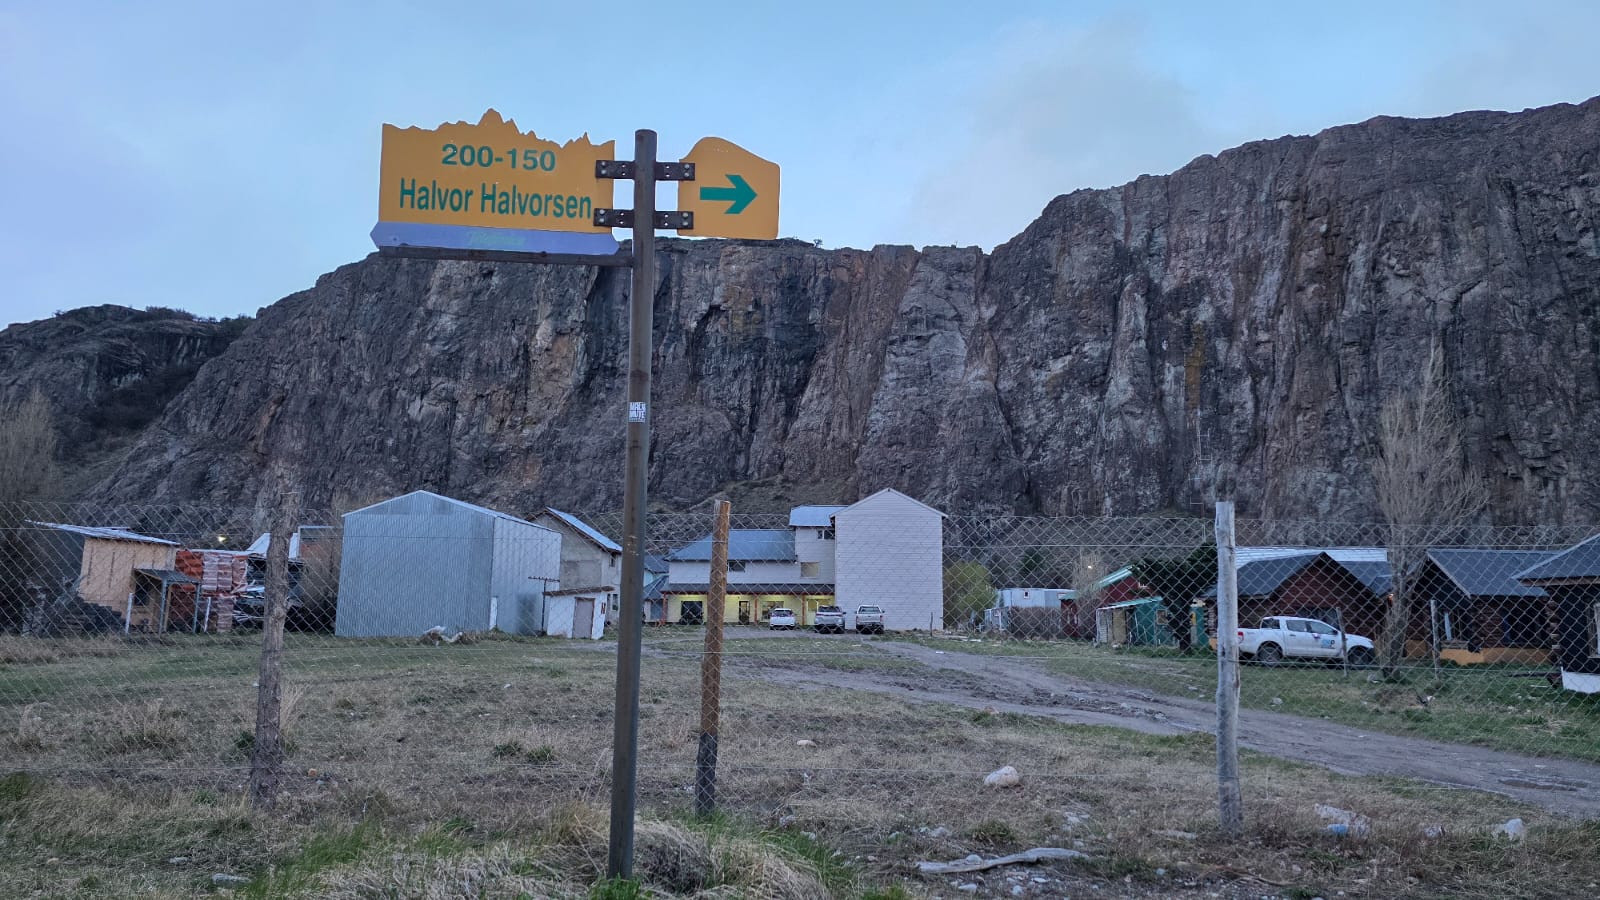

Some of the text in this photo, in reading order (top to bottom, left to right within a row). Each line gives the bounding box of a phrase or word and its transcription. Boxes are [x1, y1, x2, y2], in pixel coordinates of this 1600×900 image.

[441, 144, 557, 172] 200-150
[400, 177, 592, 220] Halvor Halvorsen
